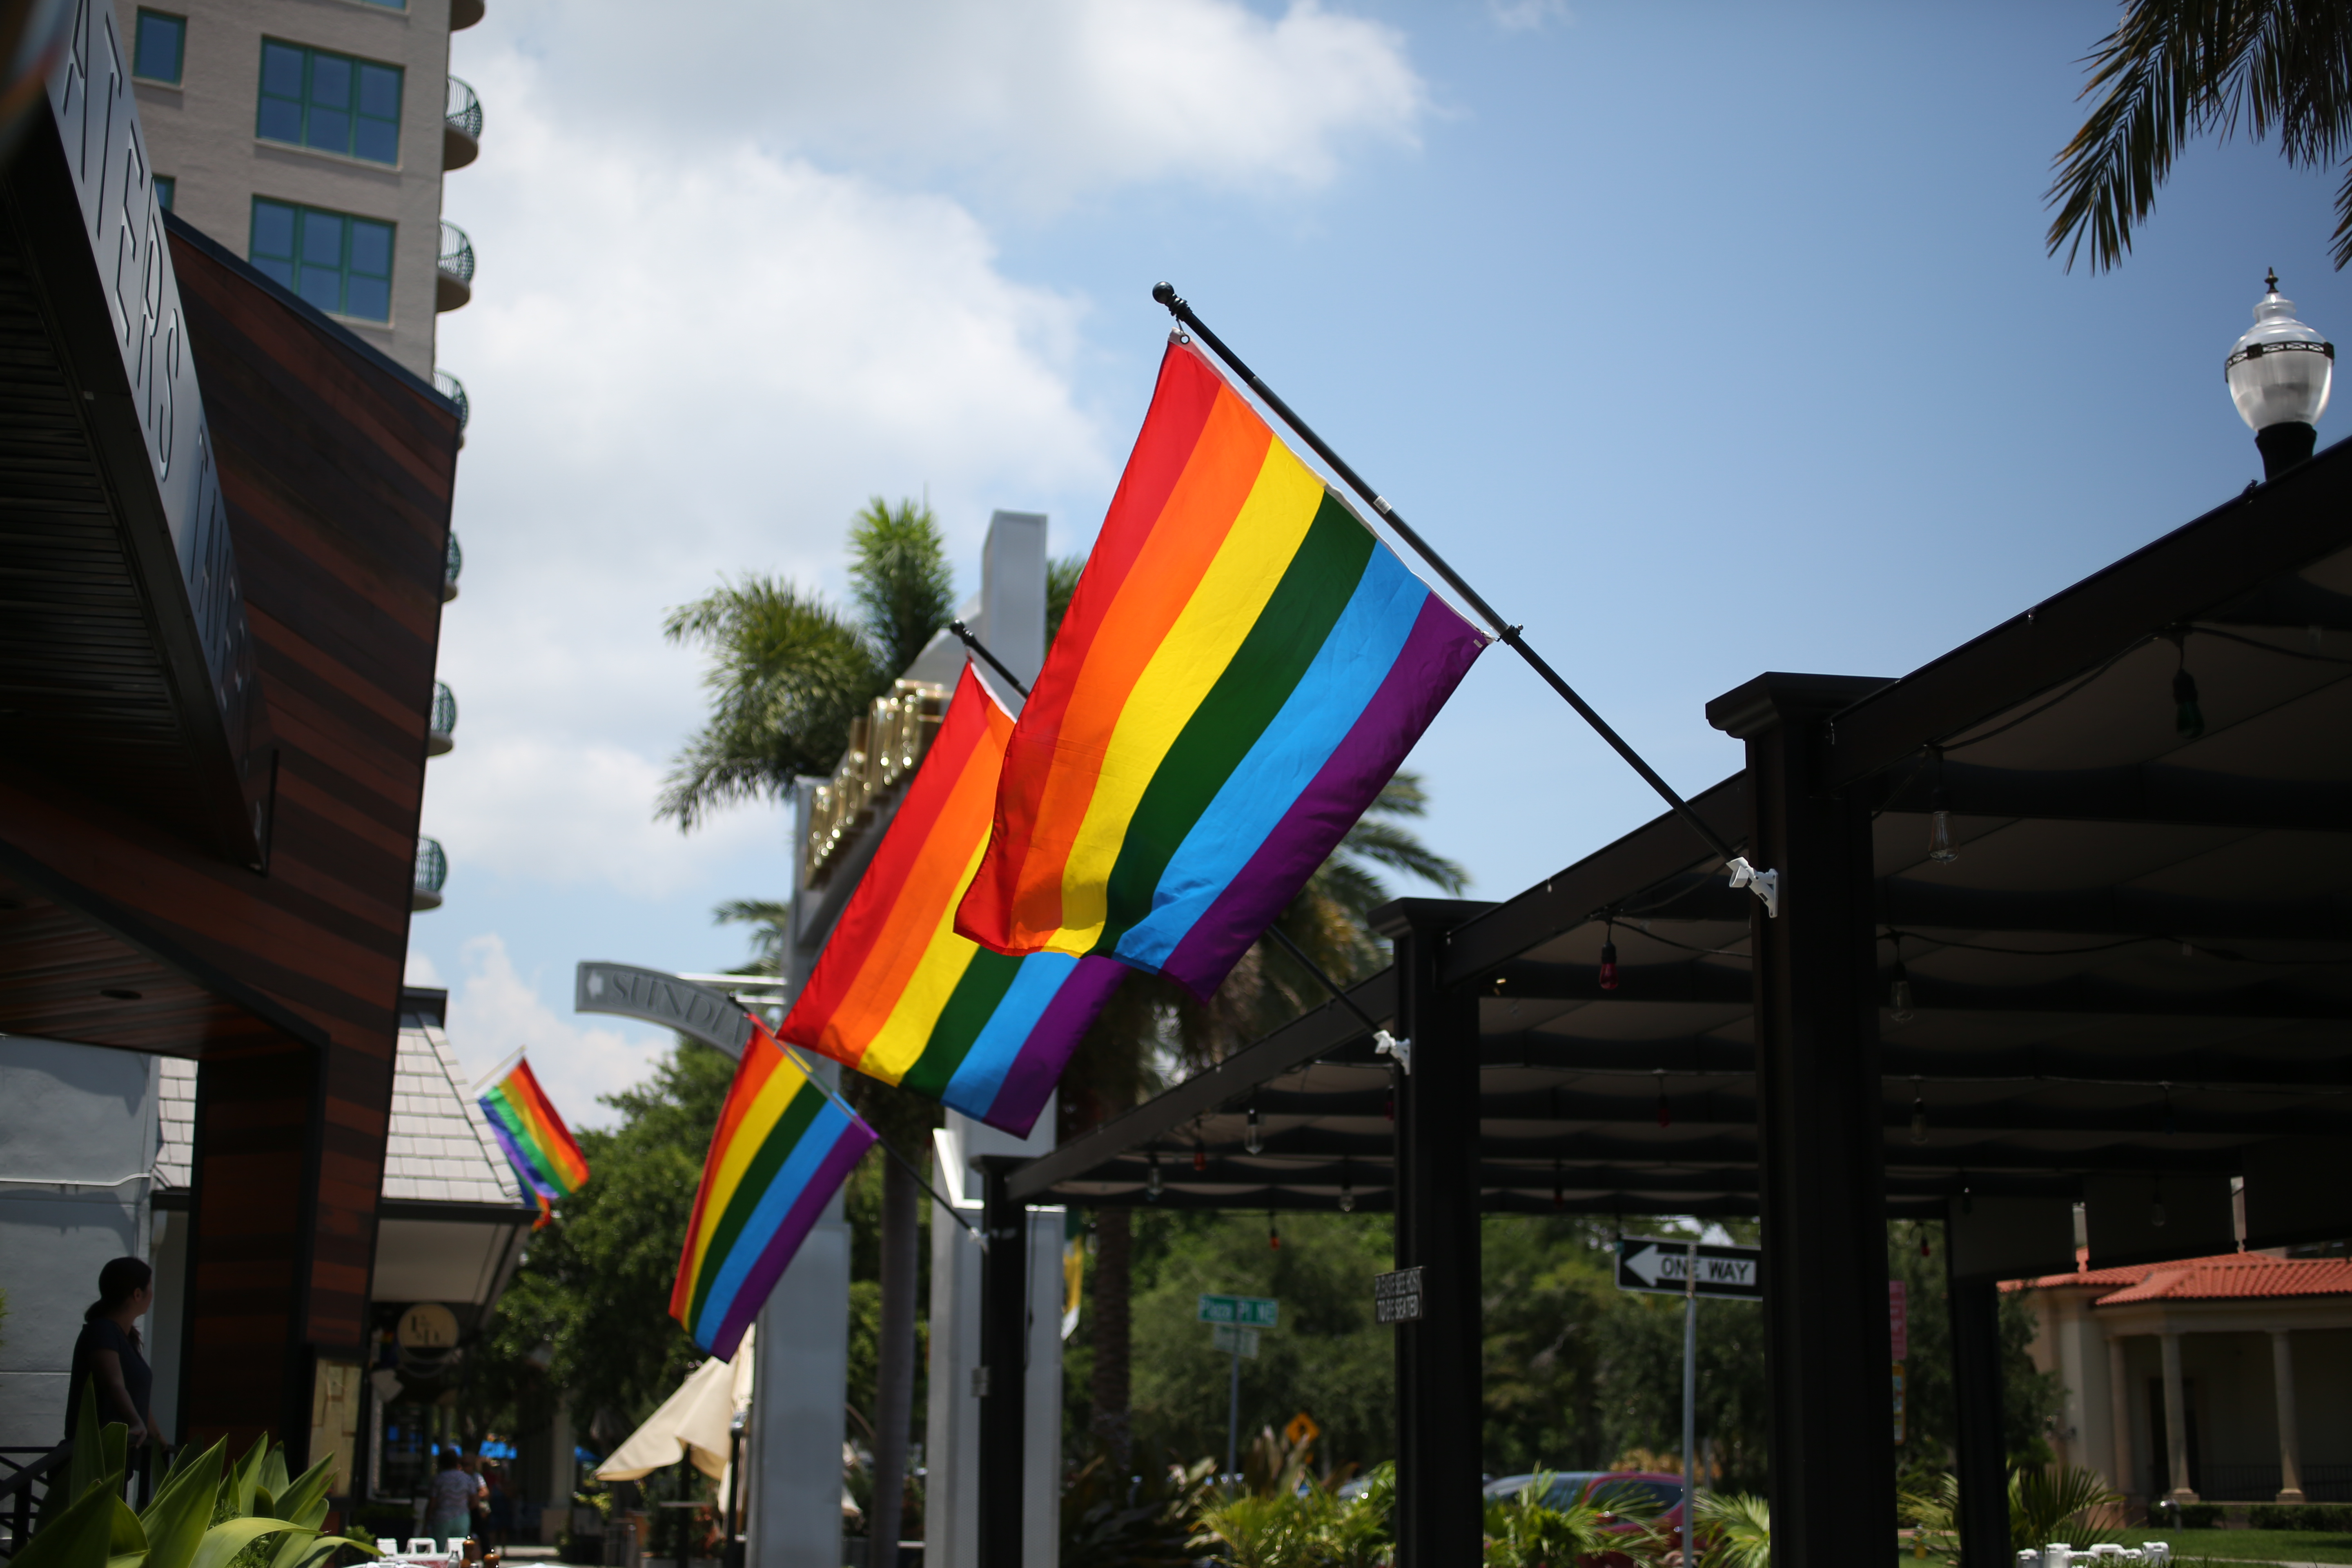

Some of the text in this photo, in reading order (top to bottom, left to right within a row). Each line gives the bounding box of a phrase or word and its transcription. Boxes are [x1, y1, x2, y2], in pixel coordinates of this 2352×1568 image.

[190, 425, 256, 778] TAVERN
[608, 969, 750, 1050] SUNDIA
[1662, 1257, 1748, 1281] ONE WAY
